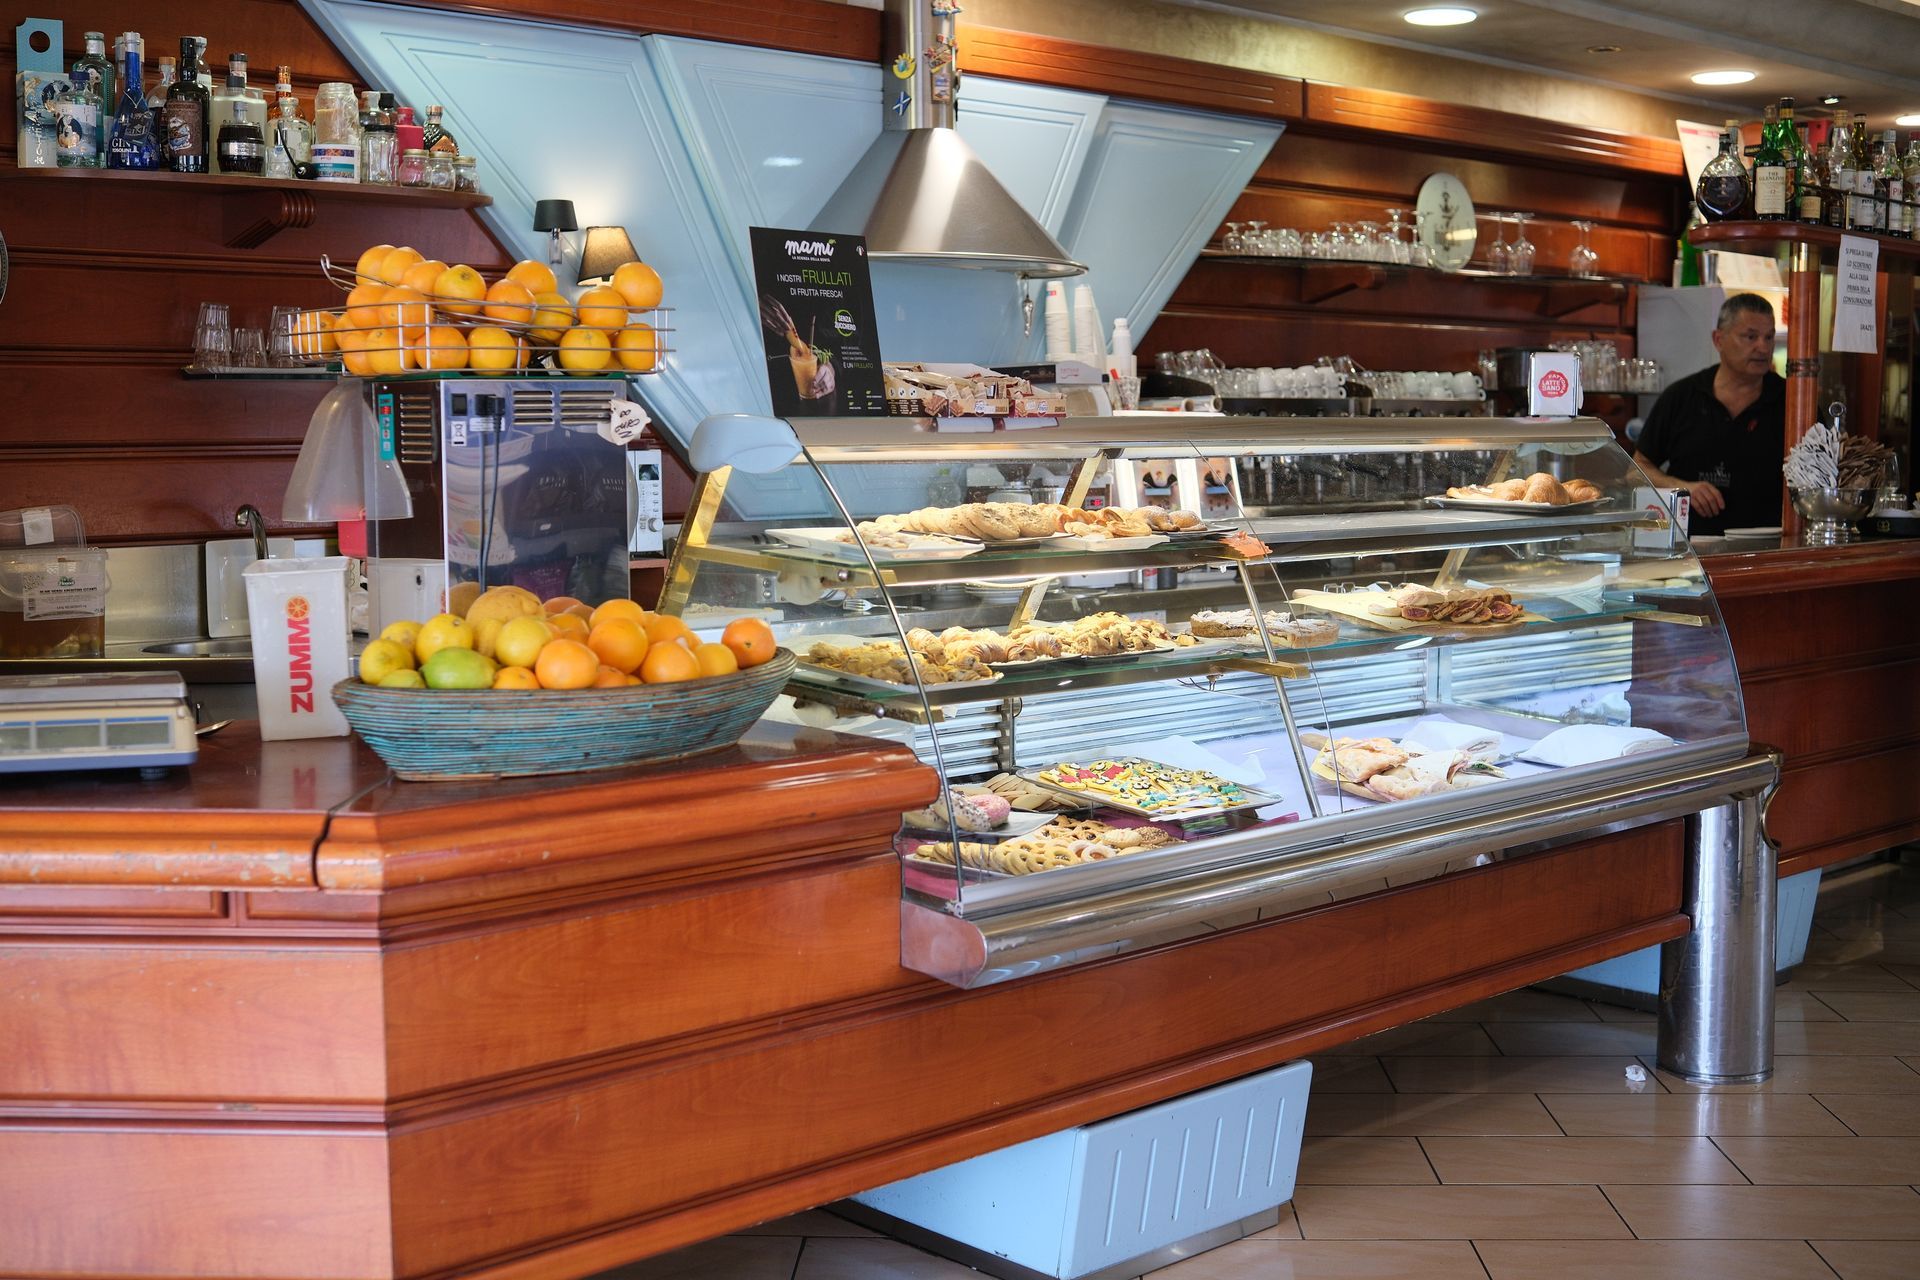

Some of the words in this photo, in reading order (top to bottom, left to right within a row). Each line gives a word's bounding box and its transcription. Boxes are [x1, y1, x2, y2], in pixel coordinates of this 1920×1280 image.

[784, 239, 836, 256] mami
[780, 274, 802, 283] NOSTRI
[802, 269, 852, 286] FRULLATI
[790, 288, 796, 296] DI
[797, 288, 819, 297] FRUTTA
[820, 289, 843, 298] FRESCA!
[838, 315, 851, 323] SENZA
[834, 321, 856, 331] ZUCCHERO
